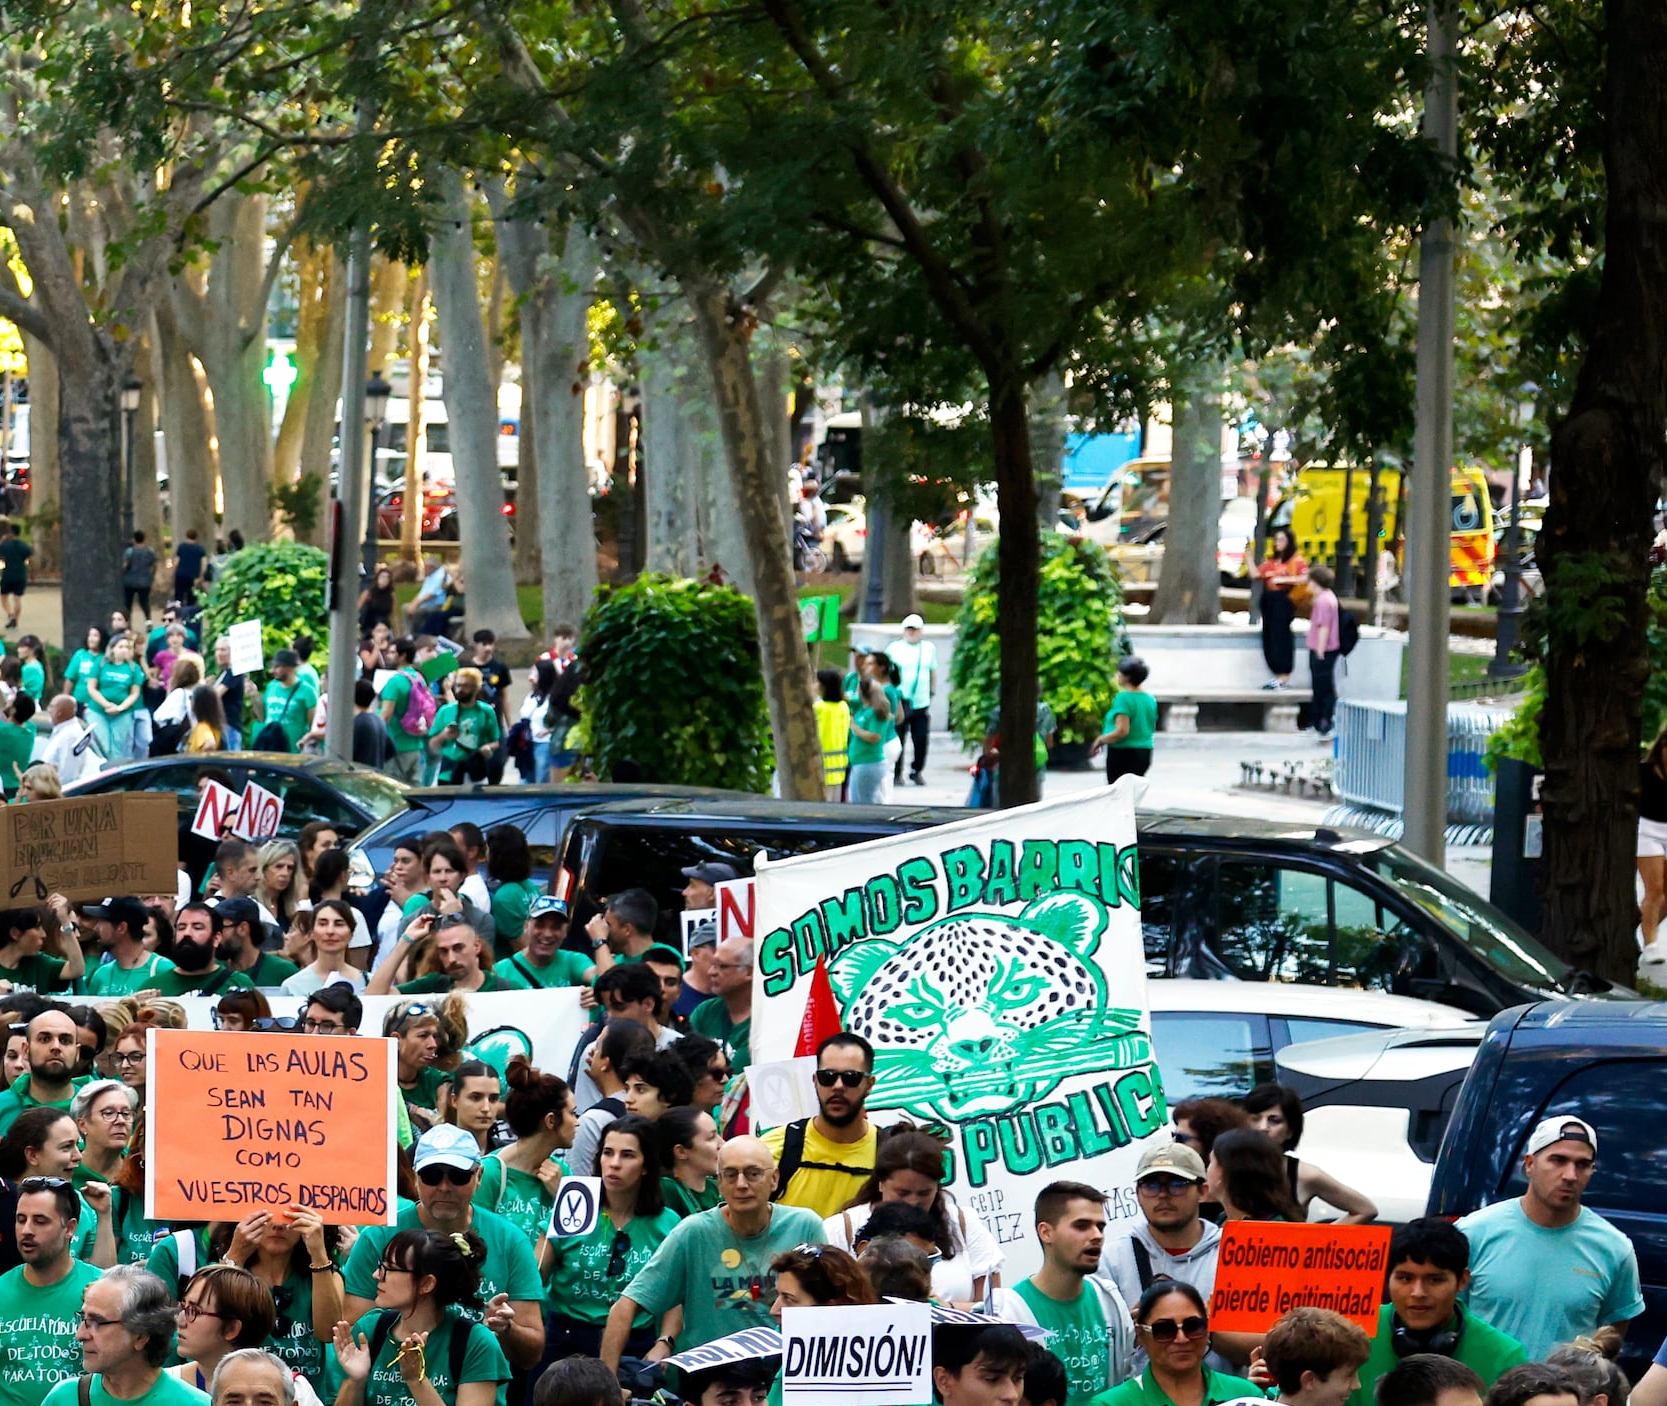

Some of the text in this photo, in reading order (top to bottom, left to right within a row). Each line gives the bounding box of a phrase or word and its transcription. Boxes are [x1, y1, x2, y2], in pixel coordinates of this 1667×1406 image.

[13, 803, 117, 843] POR UNA
[758, 856, 939, 998] SOMOS
[179, 1048, 369, 1082] QUE LAS AULAS
[207, 1088, 333, 1112] SEAN TAN
[221, 1115, 327, 1147] DIGNAS
[235, 1149, 301, 1169] COMO
[177, 1178, 388, 1216] VUESTROS DESPACHOS
[1220, 1236, 1386, 1271] Gobierno antisocial
[1211, 1284, 1269, 1315] pierde
[784, 1323, 927, 1377] DIMISIÓN!
